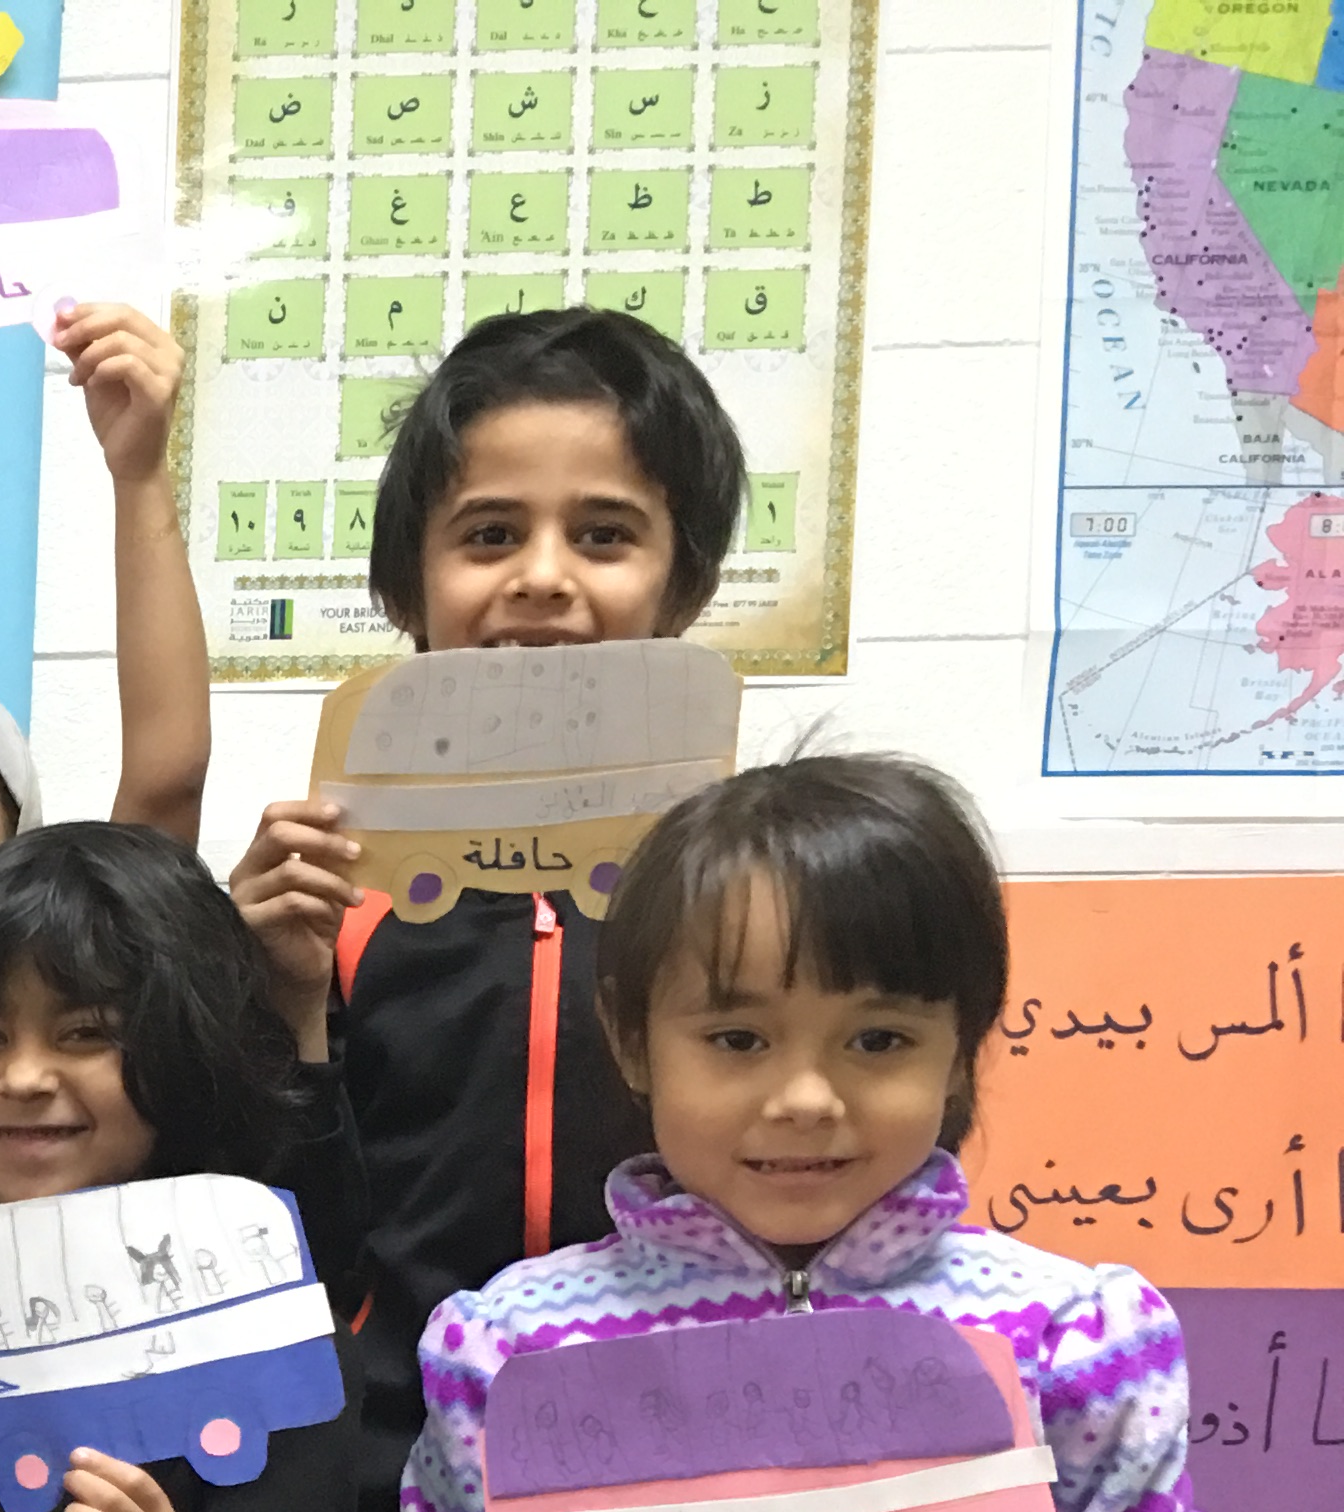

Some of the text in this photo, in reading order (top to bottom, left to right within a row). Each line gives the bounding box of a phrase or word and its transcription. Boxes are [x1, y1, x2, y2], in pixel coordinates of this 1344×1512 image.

[1217, 3, 1299, 15] OREGON
[1253, 180, 1331, 193] NEVADA
[1152, 254, 1249, 266] CALIFORNIA
[1243, 435, 1281, 444] BAJA
[1219, 453, 1306, 464] CALIFORNIA
[1086, 517, 1128, 532] 7:00
[1305, 569, 1342, 579] ALA
[320, 608, 387, 619] YOUR BRIDG
[339, 622, 394, 633] EAST AND
[463, 836, 574, 871] حافلة
[1178, 942, 1307, 1061] ألمس
[1000, 997, 1153, 1057] بيدي
[1181, 1133, 1307, 1244] أرى
[1189, 1330, 1287, 1453] أذو
